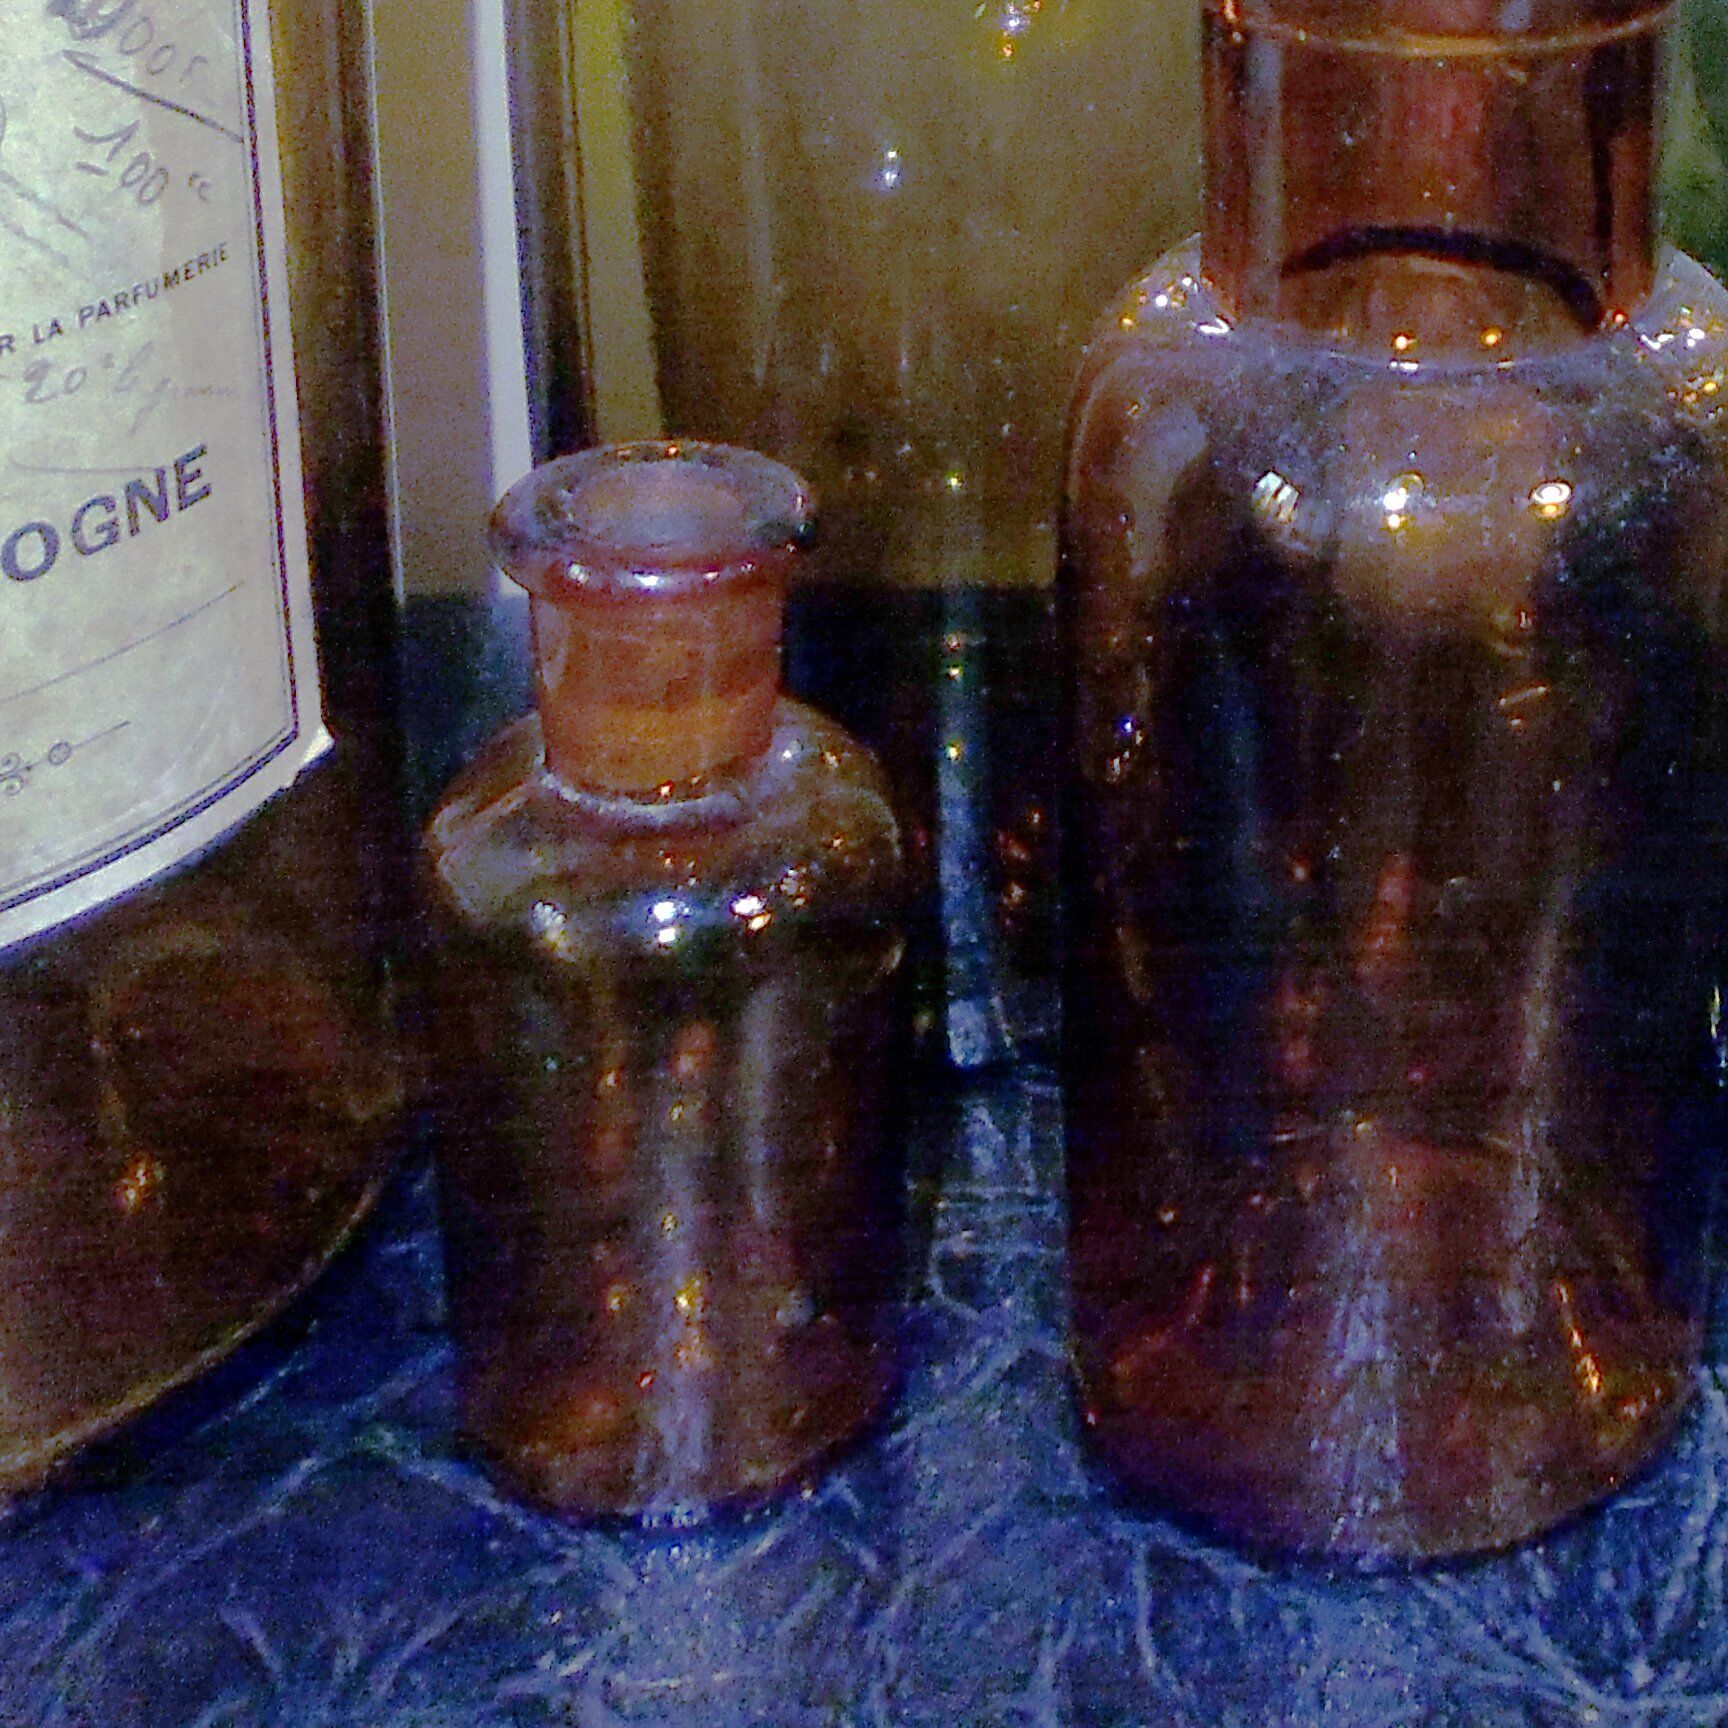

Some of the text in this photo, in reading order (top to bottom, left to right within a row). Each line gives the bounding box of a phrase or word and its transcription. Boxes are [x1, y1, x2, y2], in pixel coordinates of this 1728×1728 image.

[32, 319, 64, 345] LA
[77, 241, 230, 328] PARFUMERIE
[0, 442, 213, 582] OGNE
